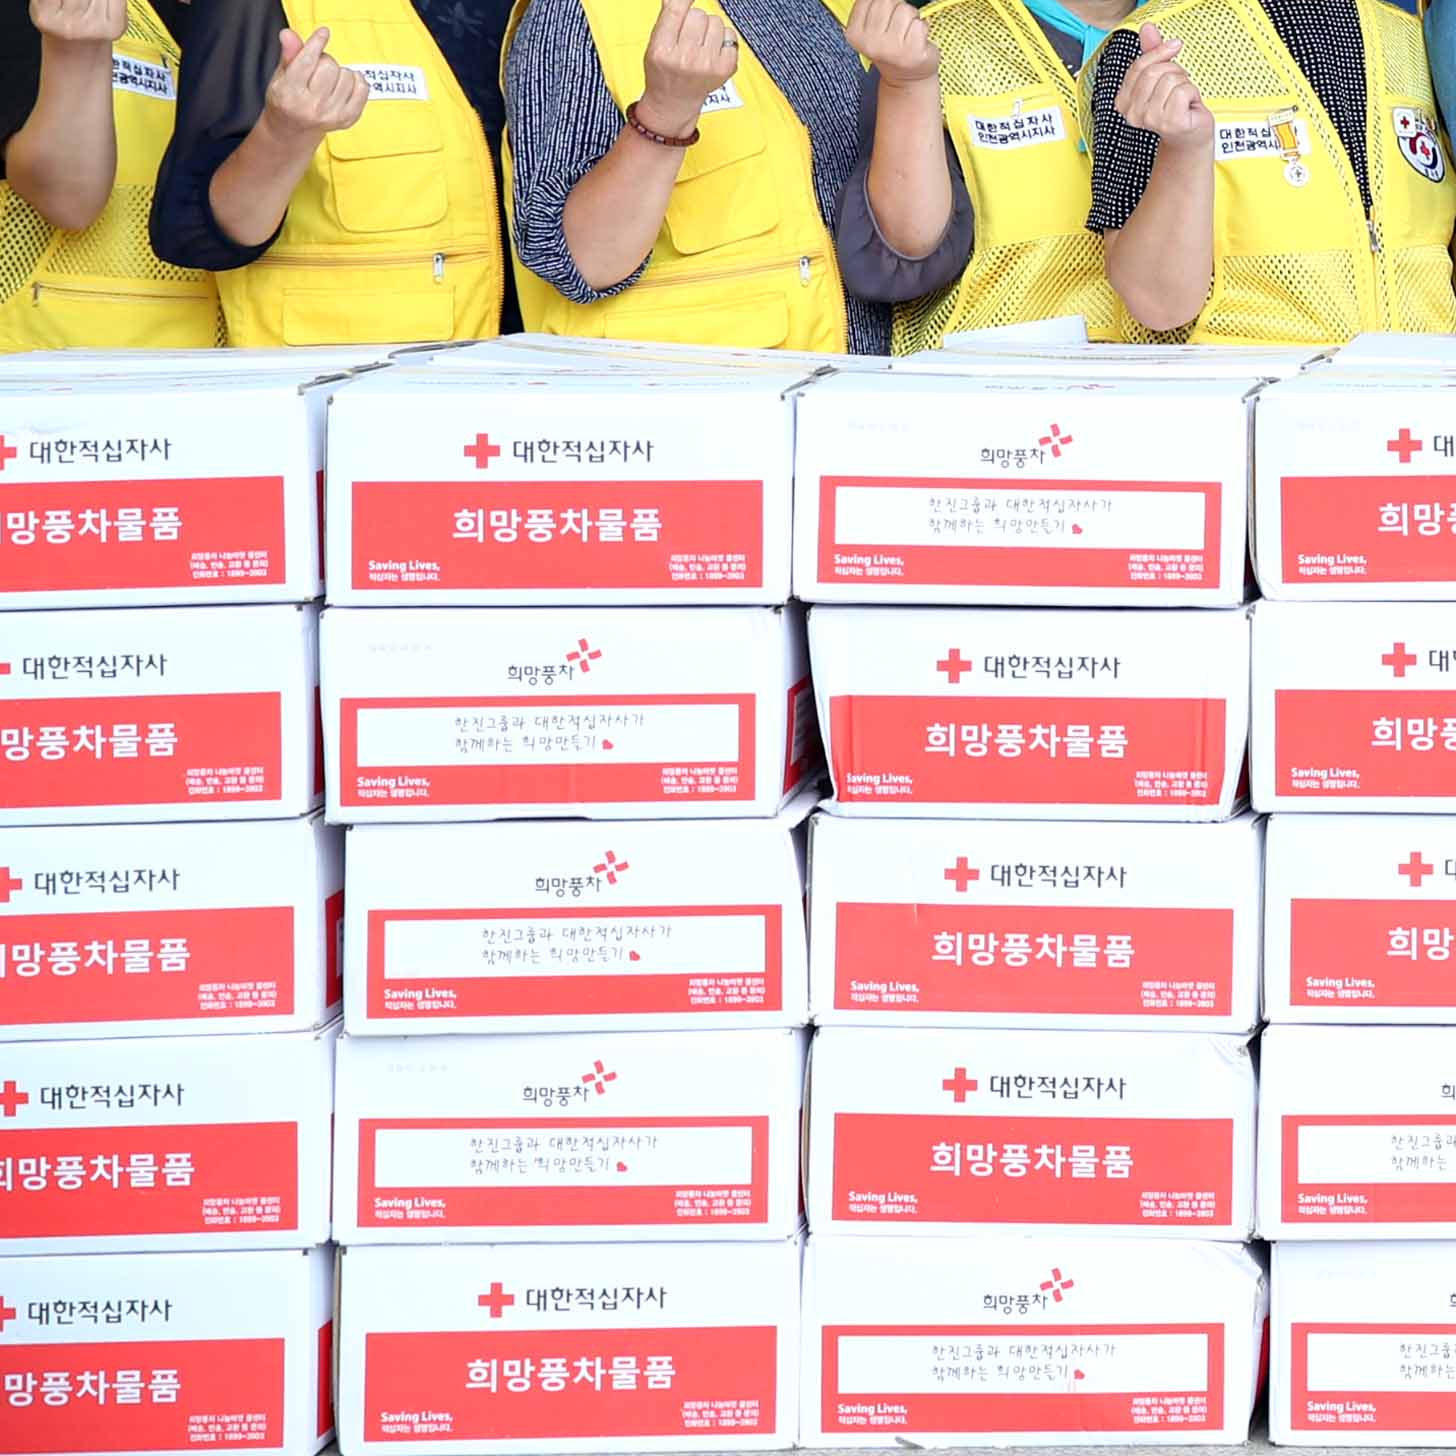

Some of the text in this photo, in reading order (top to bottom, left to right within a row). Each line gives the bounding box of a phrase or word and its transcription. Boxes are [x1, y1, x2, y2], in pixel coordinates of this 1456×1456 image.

[30, 438, 172, 464] 대한적십자사
[513, 439, 654, 463] 대한적십자사
[980, 448, 1047, 468] 희망풍차
[0, 507, 182, 545] 망풍차물품
[453, 508, 662, 543] 희망풍차물품
[368, 559, 441, 572] Saving Lives,
[23, 654, 167, 680] 대한적십자사
[507, 664, 576, 686] 희망풍차
[984, 654, 1120, 679] 대한적십자사
[925, 723, 1129, 758] 희망풍차물품
[356, 776, 429, 789] Saving Lives,
[35, 868, 180, 896] 대한적십자사
[535, 876, 604, 897] 희망풍차
[991, 863, 1127, 888] 대한적십자사
[0, 938, 191, 978] 망풍차물품
[931, 931, 1135, 968] 희망풍차물품
[40, 1083, 184, 1110] 대한적십자사
[522, 1085, 591, 1107] 희망풍차
[990, 1074, 1126, 1100] 대한적십자사
[930, 1142, 1134, 1179] 희망풍차물품
[28, 1299, 173, 1326] 대한적십자사
[526, 1287, 667, 1312] 대한적십자사
[983, 1294, 1050, 1315] 희망풍차
[465, 1356, 676, 1393] 희망풍차물품
